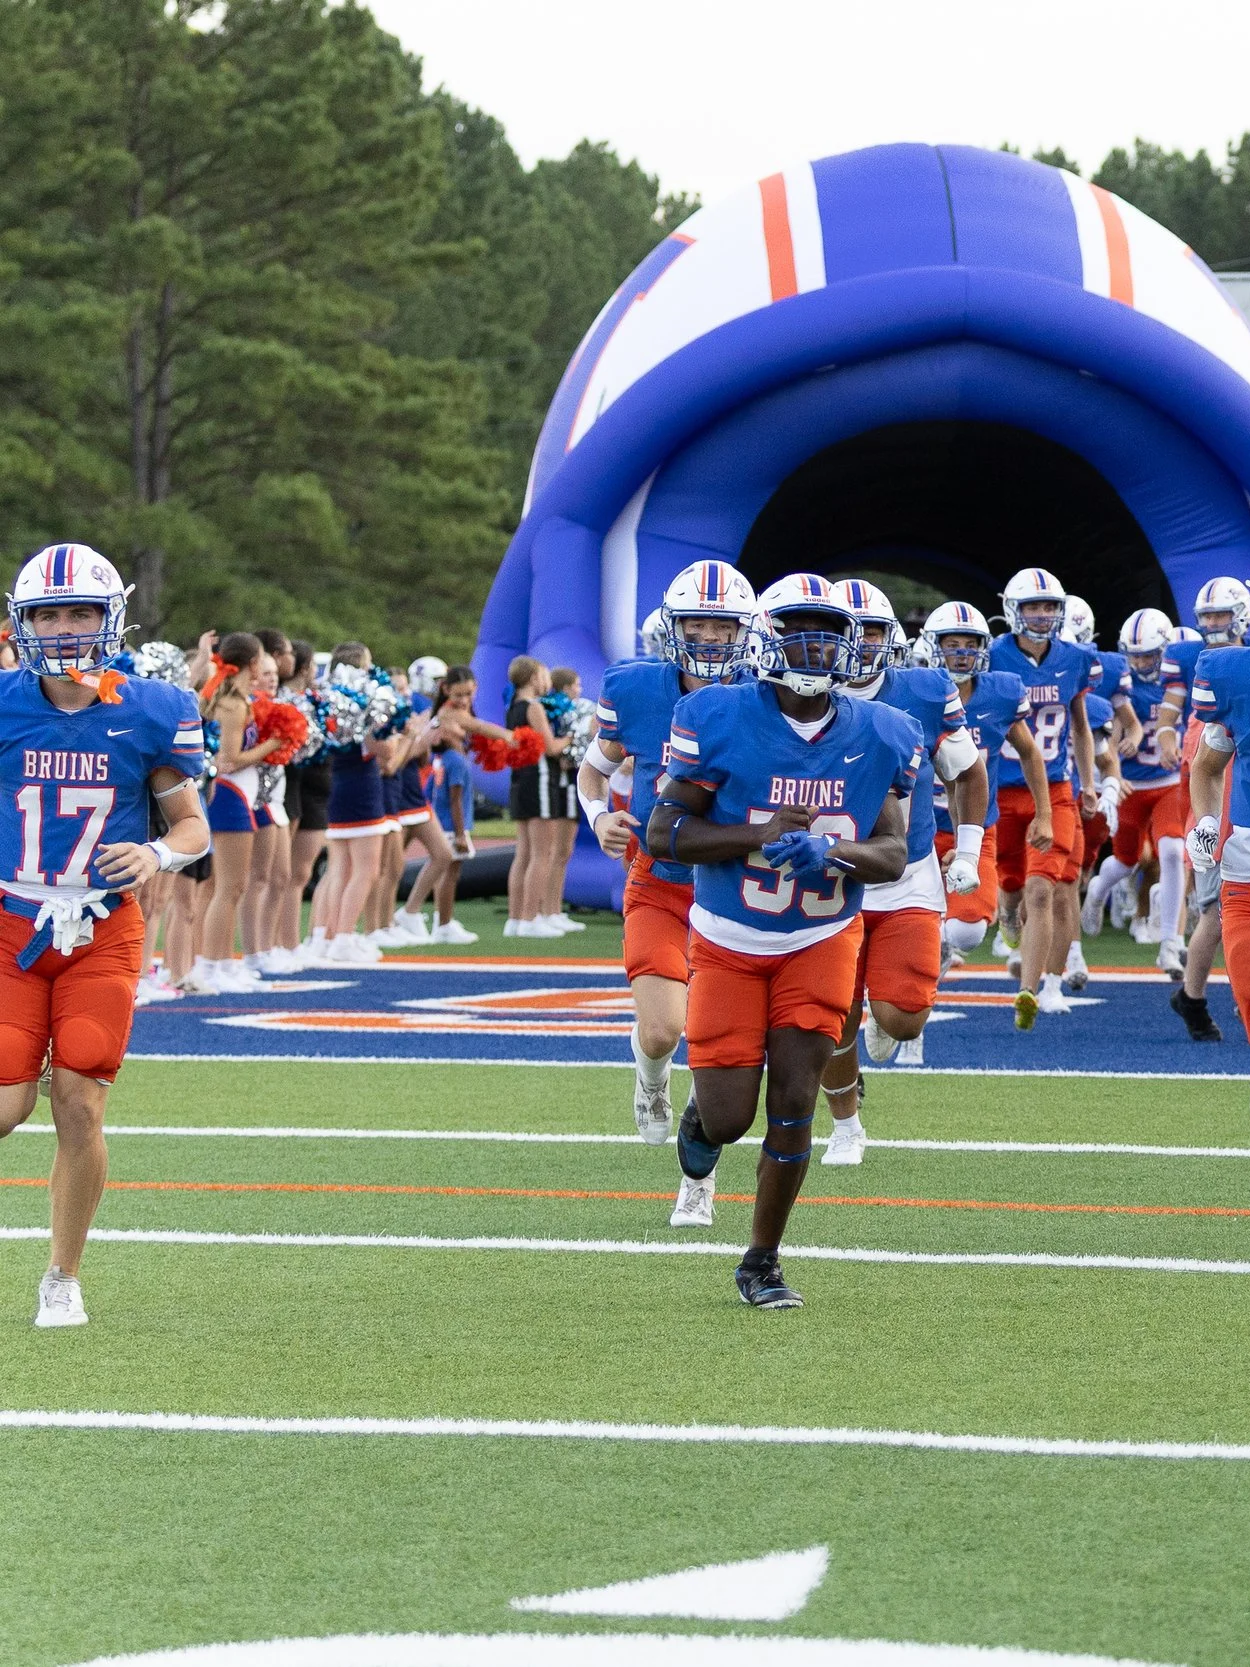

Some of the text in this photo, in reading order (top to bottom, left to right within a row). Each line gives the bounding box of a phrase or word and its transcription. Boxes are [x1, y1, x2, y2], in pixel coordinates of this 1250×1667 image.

[43, 587, 75, 595] Riddell
[699, 602, 725, 610] Riddell
[1026, 685, 1059, 703] RUINS
[24, 750, 109, 781] BRUINS
[769, 777, 845, 808] BRUINS
[15, 784, 116, 888] 17
